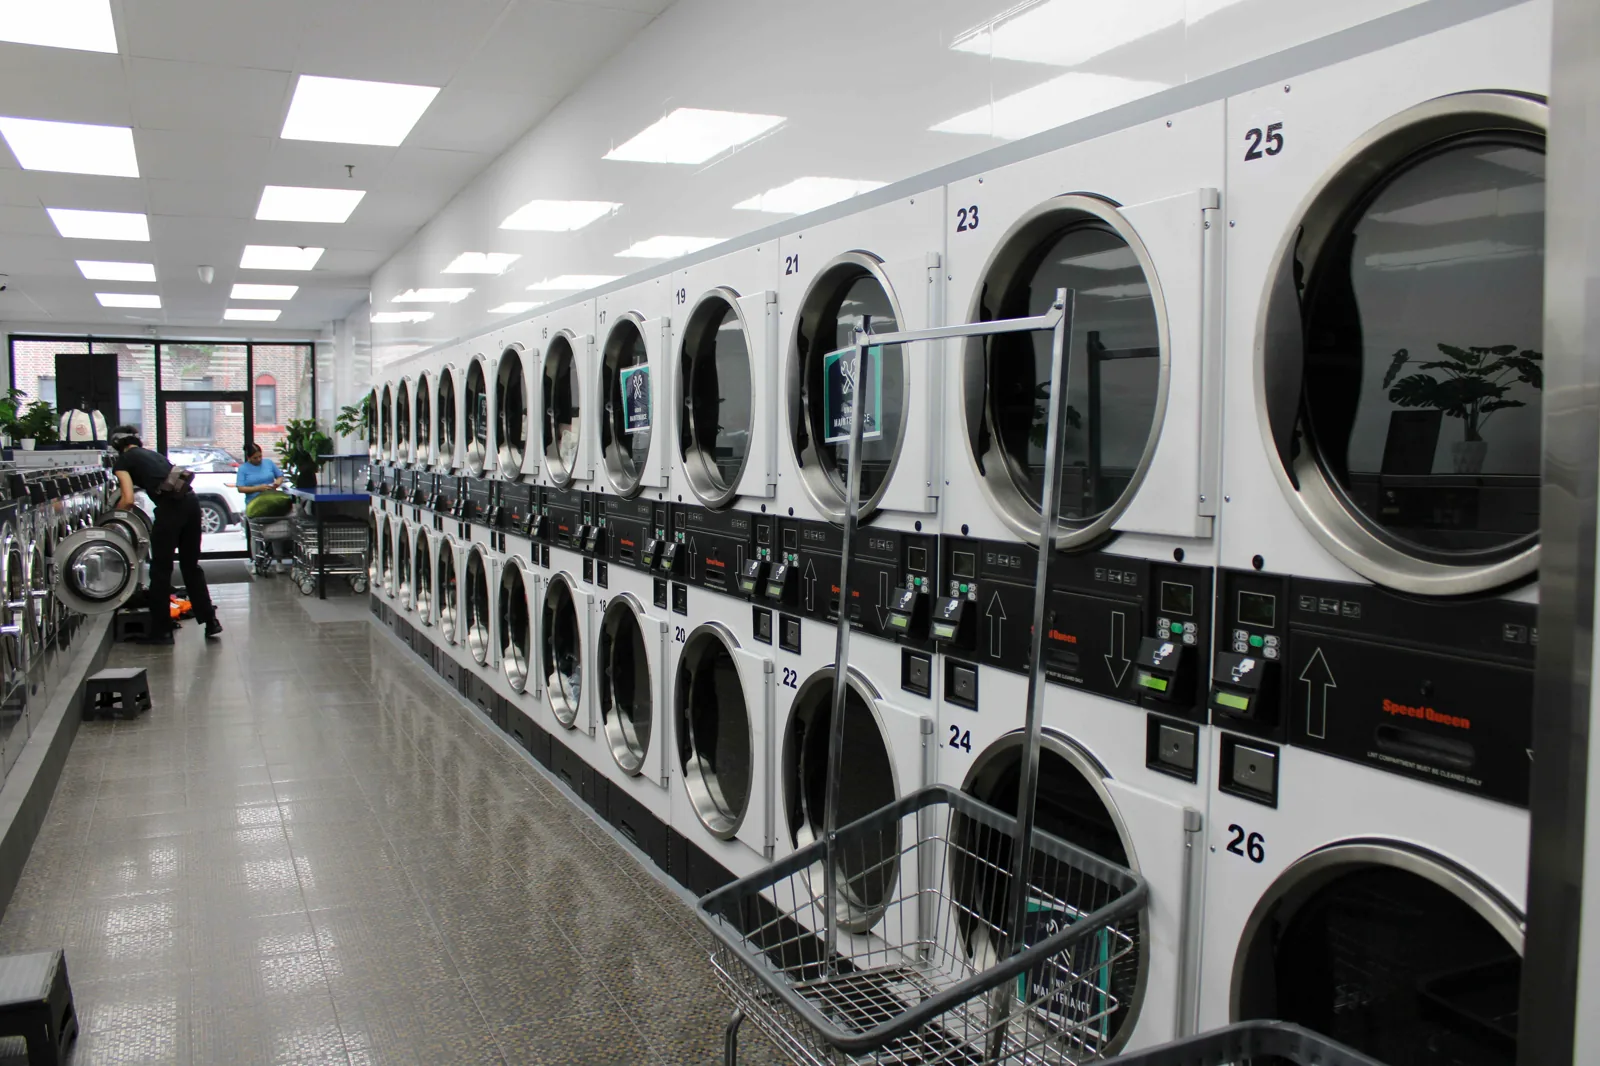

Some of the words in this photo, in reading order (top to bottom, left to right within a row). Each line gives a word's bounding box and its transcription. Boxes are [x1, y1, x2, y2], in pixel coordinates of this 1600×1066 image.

[1243, 121, 1285, 161] 25
[956, 205, 979, 232] 23
[785, 254, 799, 276] 21
[676, 288, 686, 305] 19
[599, 310, 607, 324] 17
[542, 327, 548, 340] 15
[833, 413, 870, 428] MAINTECE
[599, 599, 607, 613] 18
[675, 626, 686, 644] 20
[782, 667, 798, 690] 22
[1382, 698, 1425, 719] Speed
[1425, 707, 1471, 729] Queen
[948, 724, 972, 754] 24
[1226, 823, 1266, 864] 26
[1033, 983, 1092, 1015] MAITENANCE
